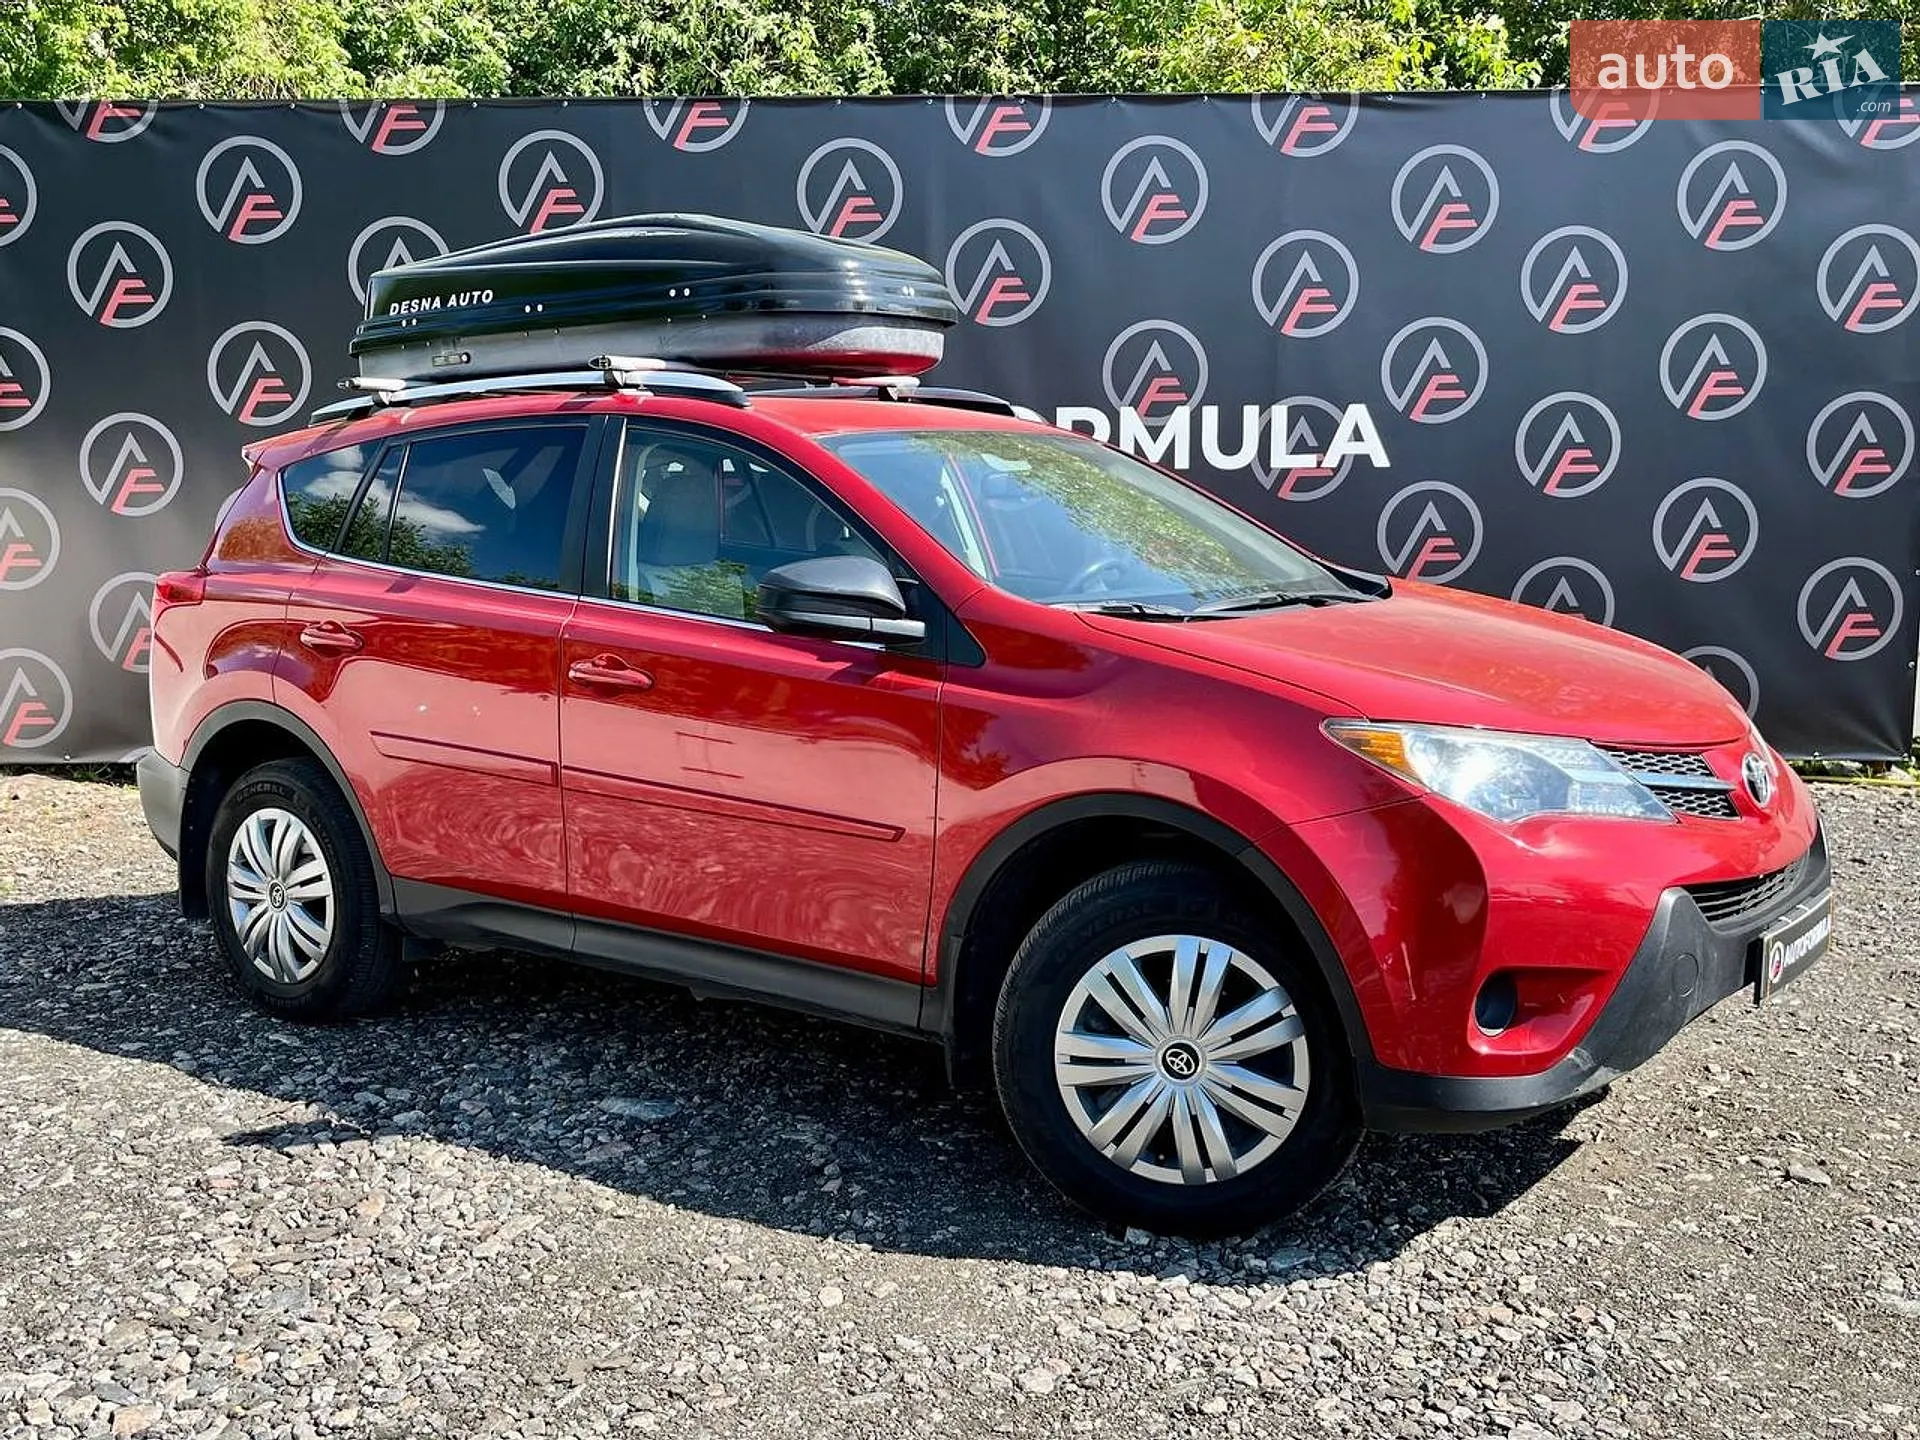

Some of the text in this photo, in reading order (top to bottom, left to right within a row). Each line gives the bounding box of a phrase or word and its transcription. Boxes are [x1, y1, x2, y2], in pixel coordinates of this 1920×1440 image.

[388, 289, 494, 316] DESNA AUTO
[1009, 403, 1391, 471] RMULA
